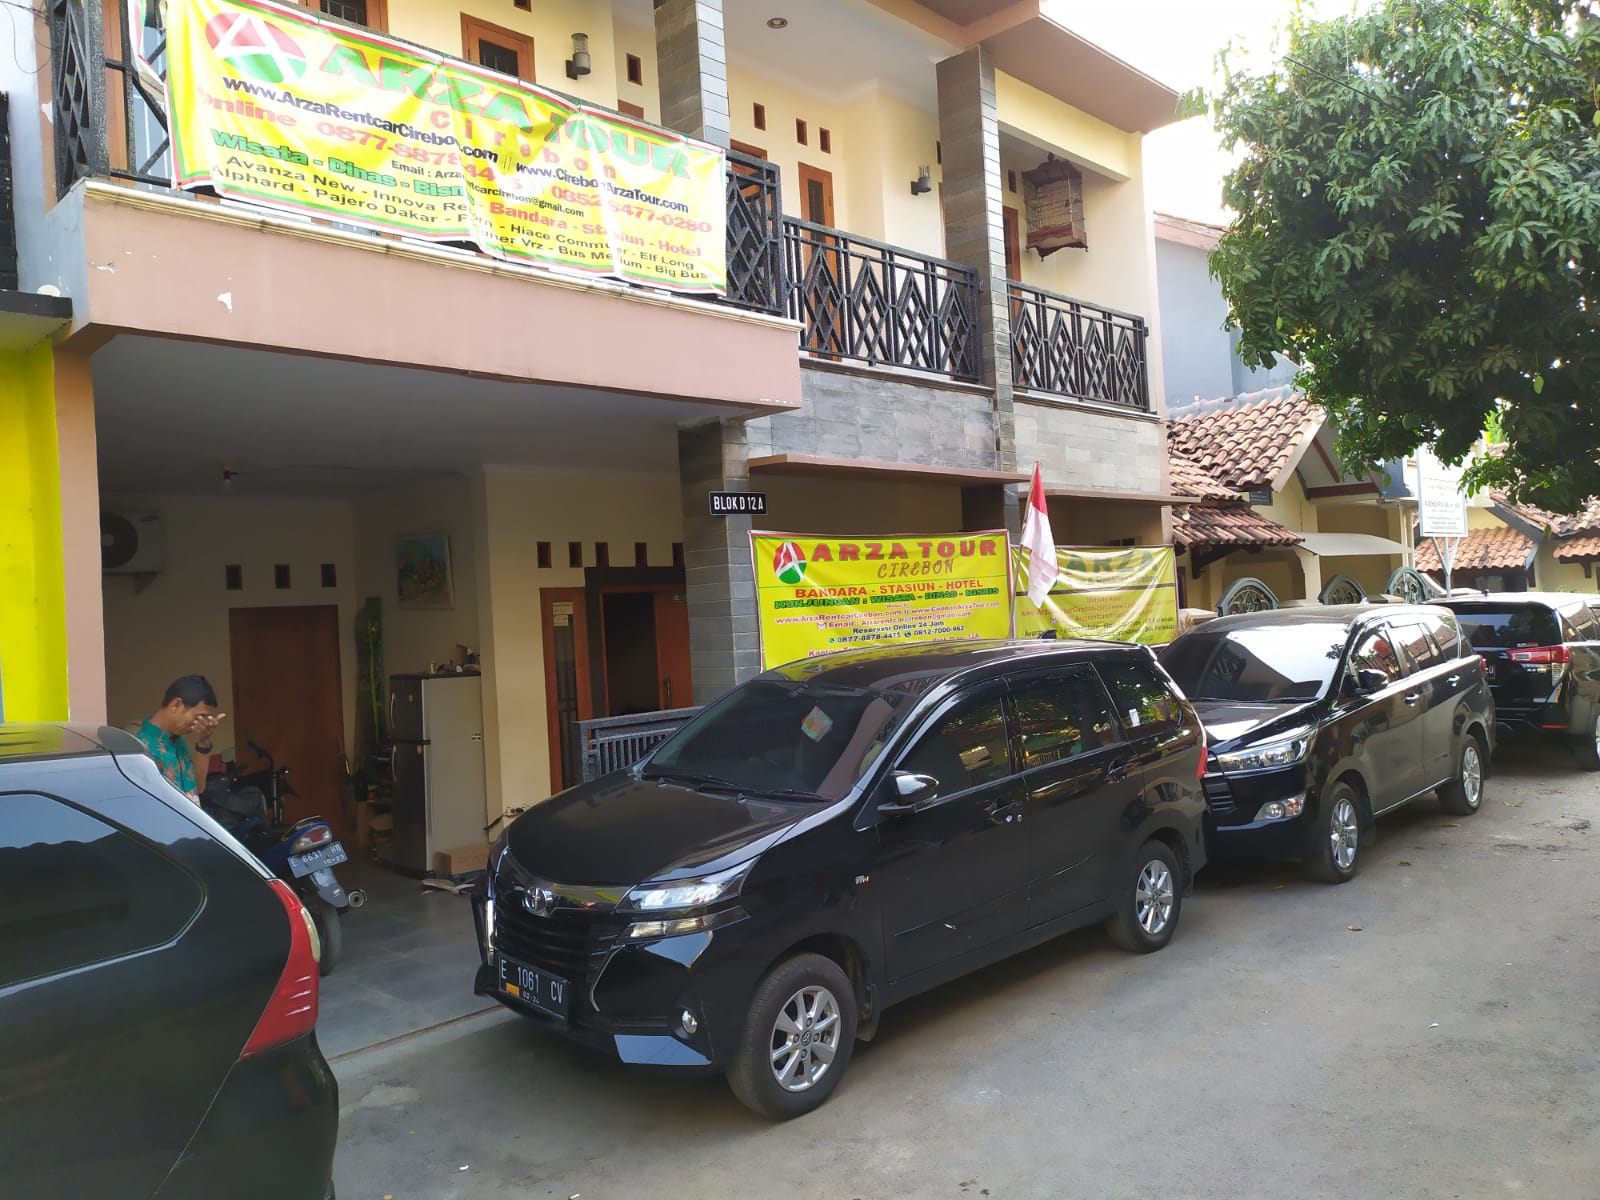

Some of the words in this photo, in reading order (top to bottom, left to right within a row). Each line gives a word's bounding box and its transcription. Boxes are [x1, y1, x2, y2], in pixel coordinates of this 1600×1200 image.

[222, 76, 499, 163] www.ArzaRentcarCirebo.com
[319, 43, 533, 134] ARZA
[544, 115, 691, 180] TOUR
[392, 160, 424, 177] Email
[210, 128, 309, 166] Wisata
[489, 201, 567, 230] Bandara
[659, 240, 703, 257] Hotel
[227, 155, 305, 183] Avanza
[313, 174, 356, 193] New
[373, 189, 435, 212] Innova
[511, 224, 551, 240] Hiace
[661, 254, 694, 271] Long
[316, 188, 378, 211] Pajero
[384, 204, 438, 223] Dakar
[559, 245, 586, 259] Bus
[656, 265, 676, 278] Big
[713, 496, 738, 510] BLOK
[811, 542, 909, 562] ARZA
[917, 540, 997, 559] TOUR
[877, 558, 954, 579] CIREBON
[795, 587, 868, 598] BANDARA
[880, 582, 935, 594] STASIUN
[946, 580, 984, 590] HOTEL
[501, 960, 508, 979] E
[517, 966, 539, 993] 1061
[550, 980, 563, 1004] CV
